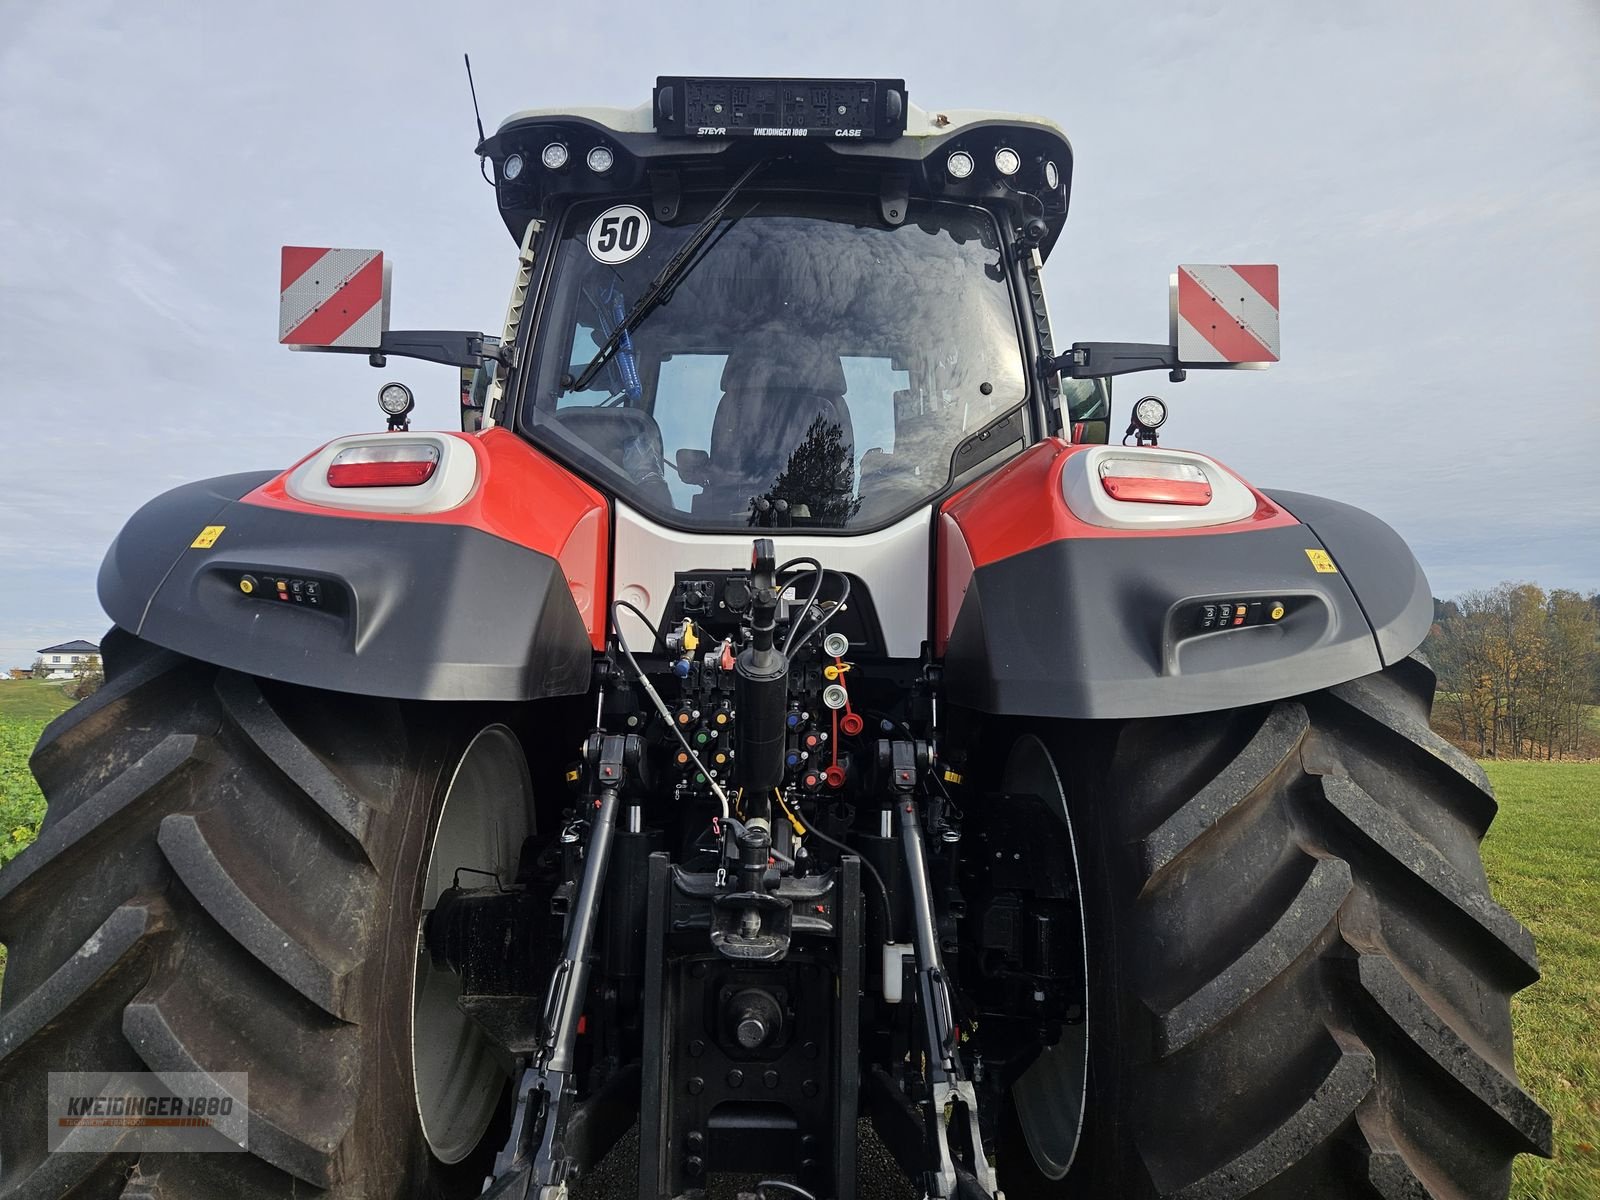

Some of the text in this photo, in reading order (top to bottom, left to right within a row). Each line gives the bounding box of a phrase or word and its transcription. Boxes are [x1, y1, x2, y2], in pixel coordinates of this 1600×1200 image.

[697, 127, 726, 135] STEYR
[753, 127, 791, 136] KNEIDINGER
[834, 129, 862, 137] CASE
[597, 215, 641, 253] 50
